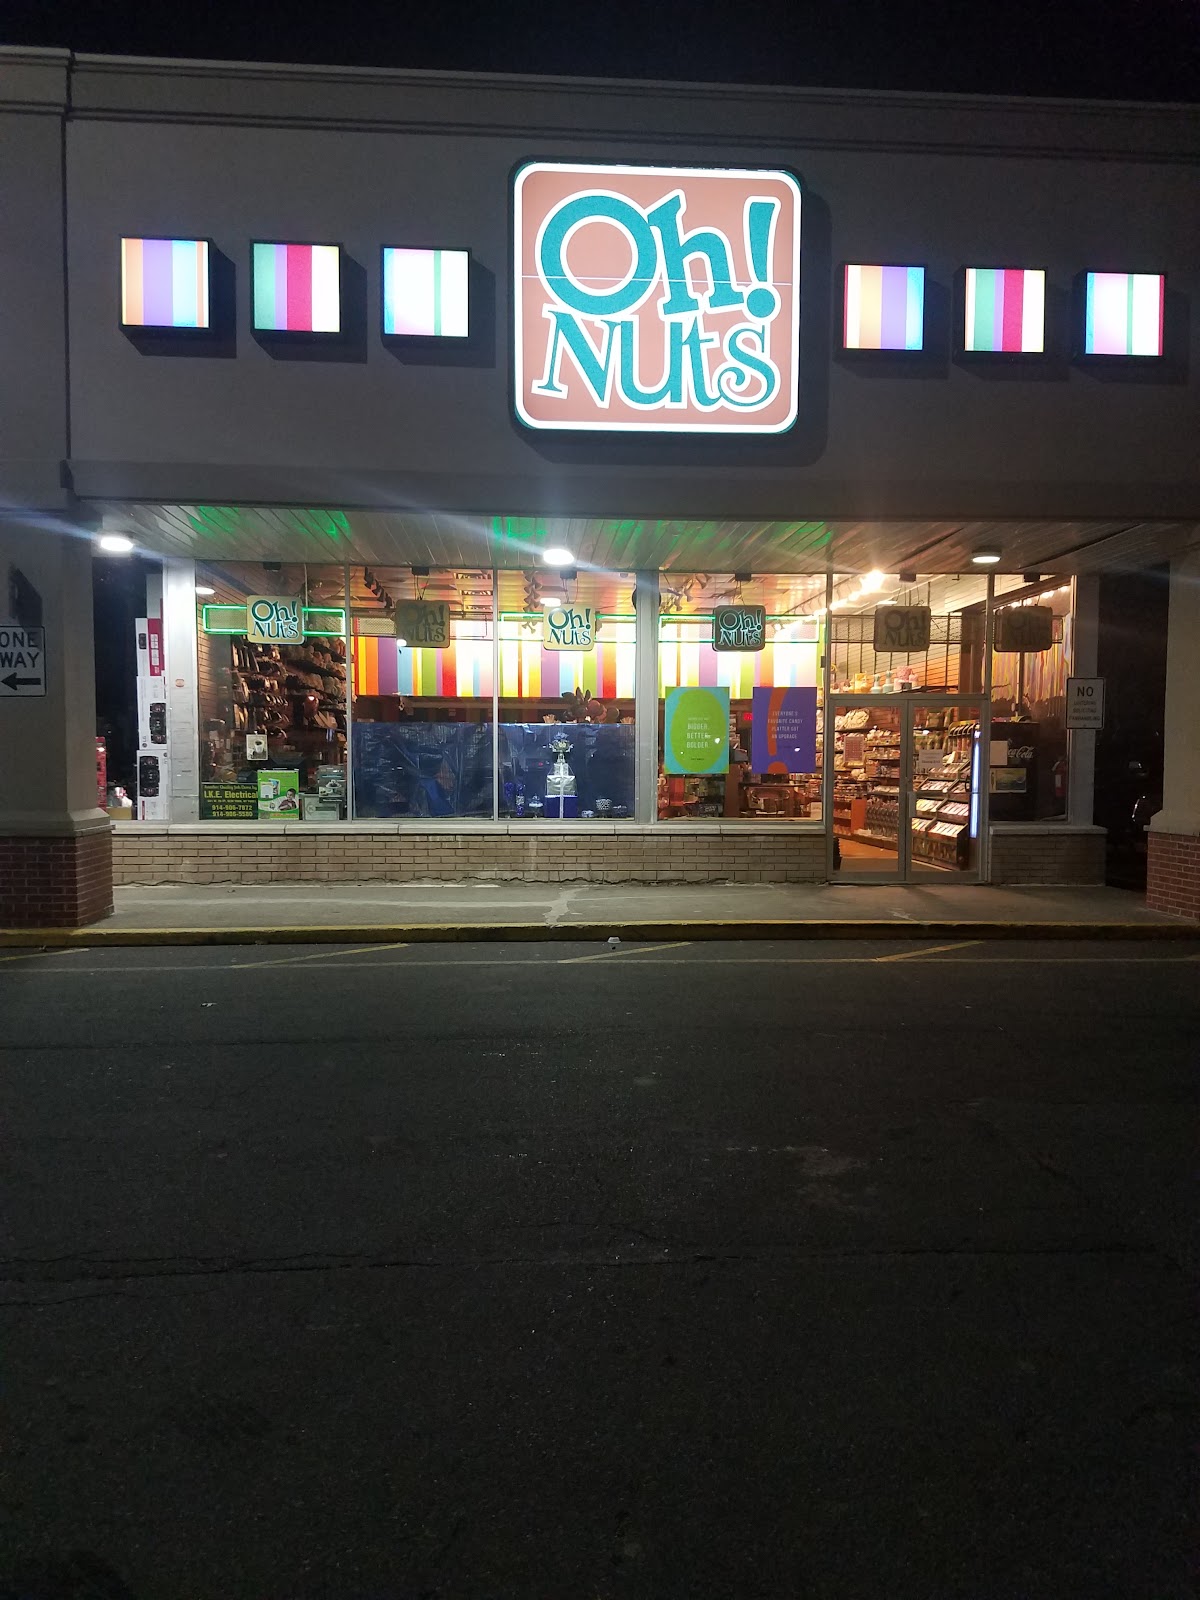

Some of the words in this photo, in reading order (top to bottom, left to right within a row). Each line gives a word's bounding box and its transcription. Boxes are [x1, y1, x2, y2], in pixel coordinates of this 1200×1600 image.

[540, 194, 777, 318] Oh!
[536, 308, 776, 406] Nuts
[252, 599, 298, 622] Oh!
[548, 607, 592, 630] Oh!
[251, 620, 299, 638] Nuts
[719, 609, 762, 631] Oh!
[0, 631, 39, 648] ONE
[547, 629, 592, 646] Nuts
[0, 651, 40, 668] WAY
[1077, 686, 1094, 697] NO
[203, 790, 223, 798] I.K.E.
[224, 790, 258, 798] Electrical
